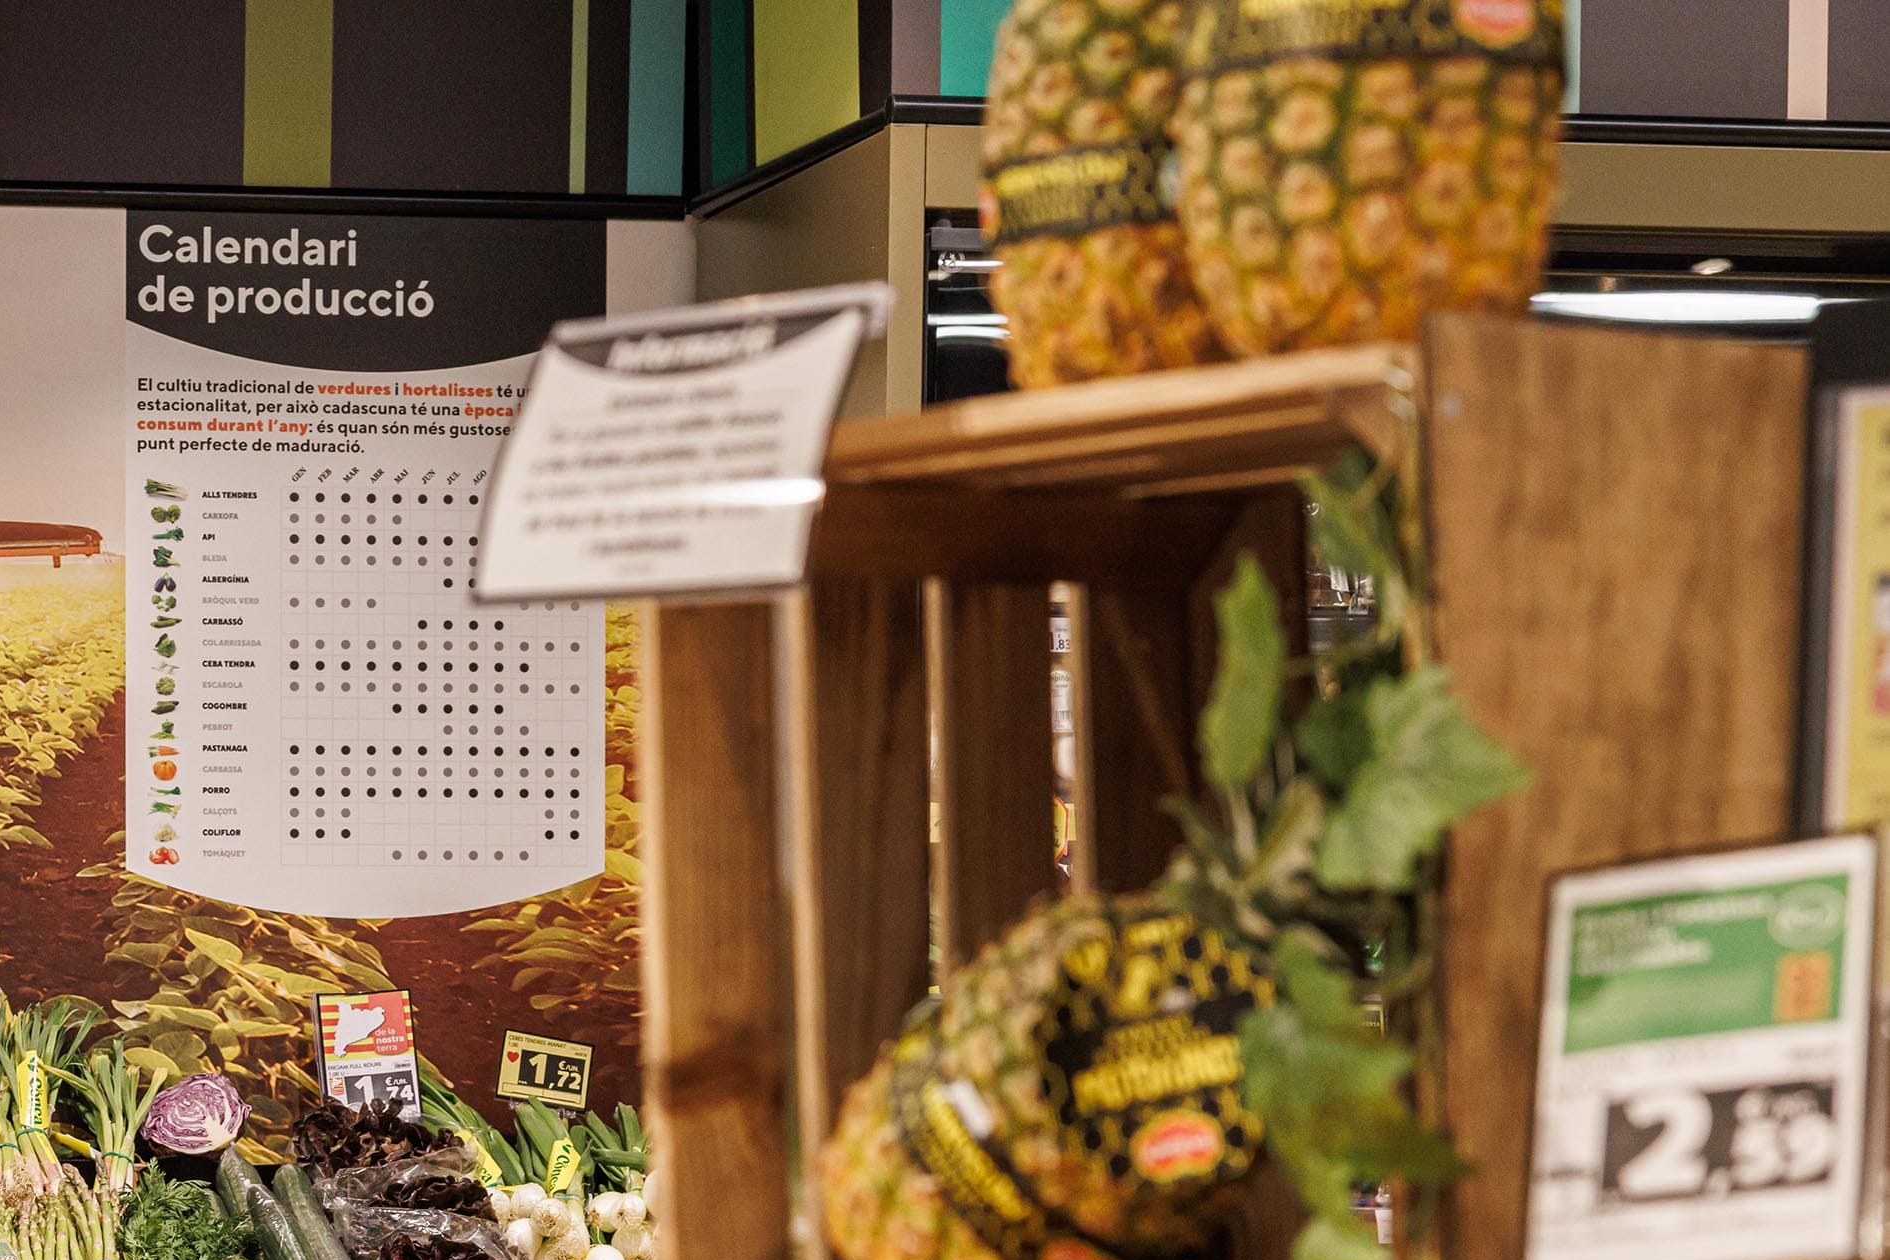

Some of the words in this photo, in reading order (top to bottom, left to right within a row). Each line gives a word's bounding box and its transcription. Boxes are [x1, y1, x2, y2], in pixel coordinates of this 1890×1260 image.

[139, 224, 357, 266] Calendari
[138, 275, 195, 313] de
[208, 278, 435, 324] producció
[137, 377, 152, 391] El
[157, 379, 202, 393] cultiu
[206, 380, 290, 394] tradicional
[295, 381, 314, 394] de
[317, 382, 391, 395] verdures
[403, 383, 493, 397] hortalisses
[497, 385, 512, 397] té
[137, 398, 252, 414] estacionalitat,
[256, 402, 282, 415] per
[286, 400, 319, 413] això
[323, 401, 406, 415] cadascuna
[411, 402, 427, 415] té
[432, 405, 460, 416] una
[464, 403, 513, 419] època
[137, 420, 202, 431] consum
[207, 418, 264, 432] durant
[317, 420, 334, 434] és
[338, 422, 378, 435] quan
[381, 421, 409, 434] són
[414, 422, 445, 435] més
[137, 438, 175, 453] punt
[179, 437, 248, 454] perfecte
[252, 440, 272, 452] de
[276, 439, 364, 453] maduració.
[291, 466, 307, 482] GEN
[317, 468, 332, 483] FEB
[342, 466, 360, 483] MAR
[369, 468, 385, 484] ABR
[393, 468, 409, 484] MAI
[421, 469, 436, 485] JUN
[446, 471, 460, 485] JUL
[472, 469, 487, 485] AGO
[202, 491, 220, 499] ALLS
[222, 491, 257, 499] TENDRES
[202, 512, 238, 520] CARXOFA
[202, 533, 215, 541] API
[202, 554, 227, 562] BLEDA
[202, 575, 249, 583] ALBERGÍNIA
[202, 616, 243, 625] CARBASSÓ
[202, 659, 222, 667] CEBA
[224, 659, 255, 668] TENDRA
[202, 681, 243, 689] ESCAROLA
[202, 702, 247, 710] COGOMBRE
[202, 723, 233, 731] PEBROT
[202, 744, 248, 752] PASTANAGA
[202, 765, 243, 773] CARBASSA
[202, 786, 230, 794] PORRO
[202, 807, 237, 817] CALÇOTS
[202, 828, 241, 836] COLIFLOR
[376, 1035, 404, 1044] nostra
[377, 1044, 398, 1052] terra
[529, 1053, 582, 1091] 1,72
